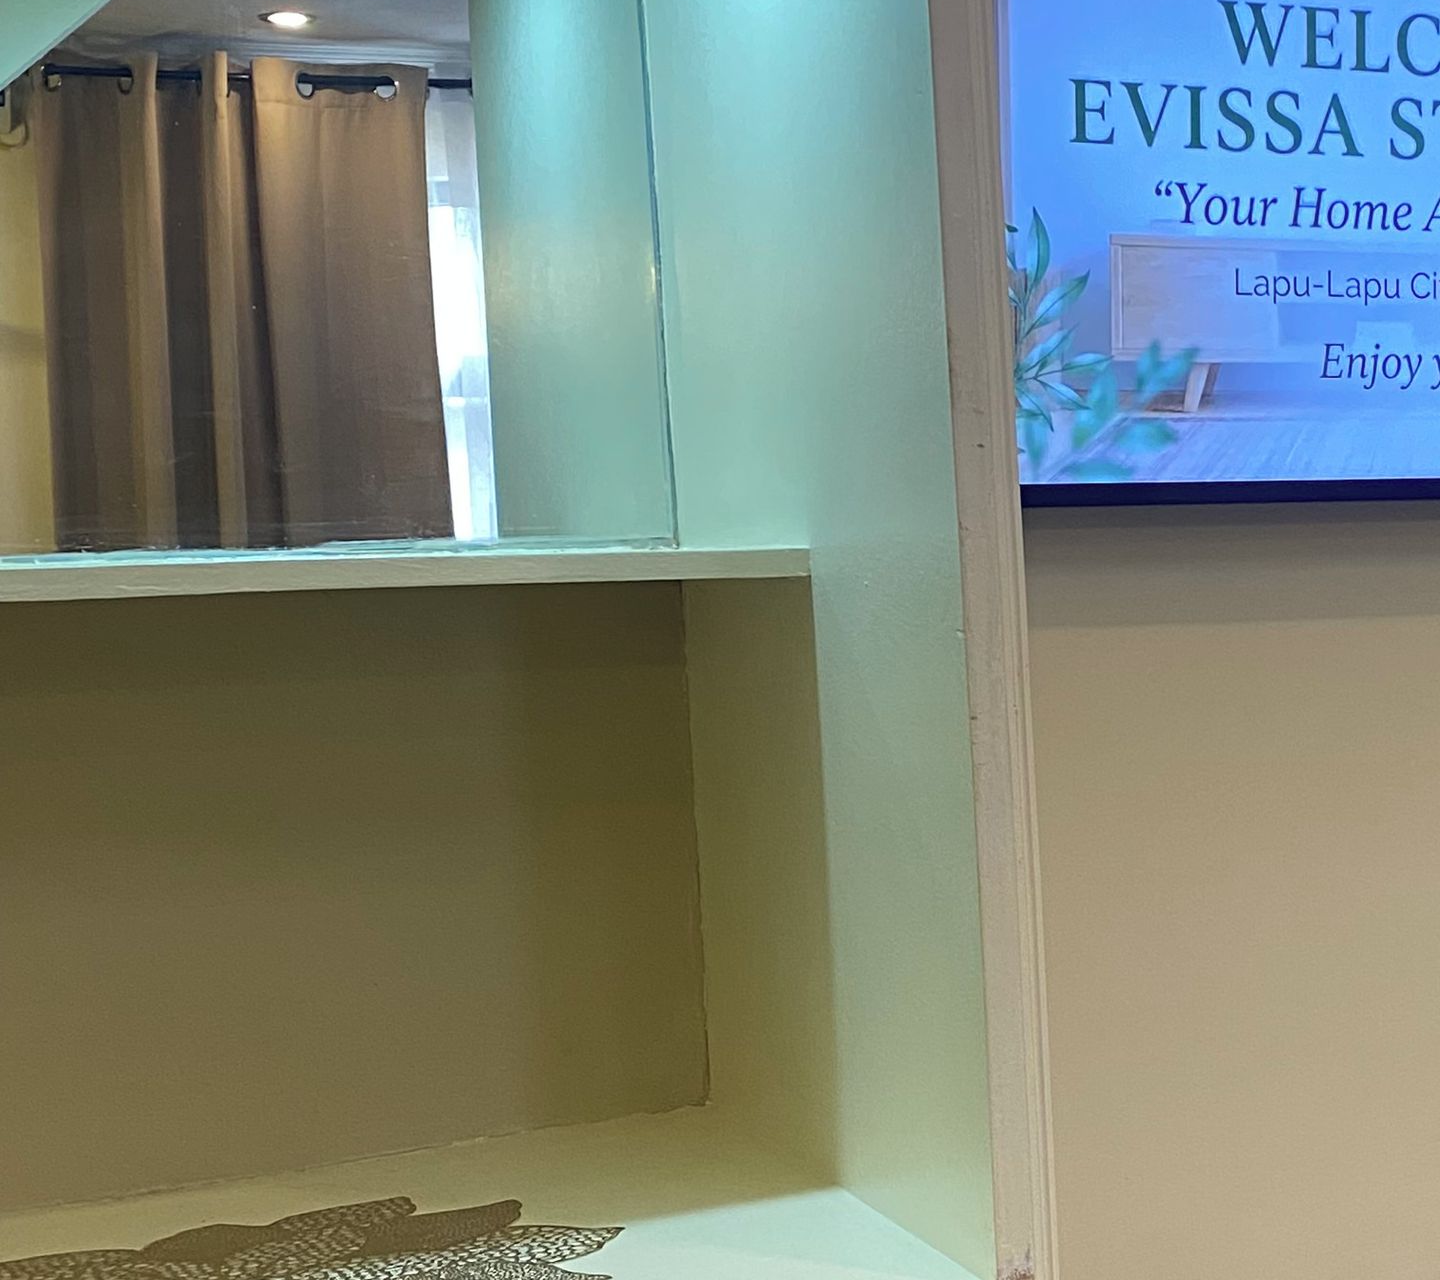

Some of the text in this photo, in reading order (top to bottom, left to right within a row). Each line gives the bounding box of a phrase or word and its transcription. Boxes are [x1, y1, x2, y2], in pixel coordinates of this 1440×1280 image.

[1069, 78, 1364, 158] EVISSA
[1154, 181, 1277, 228] “Your
[1290, 186, 1412, 232] Home
[1234, 267, 1402, 306] Lapu-Lapu
[1320, 342, 1421, 390] Enjoy
